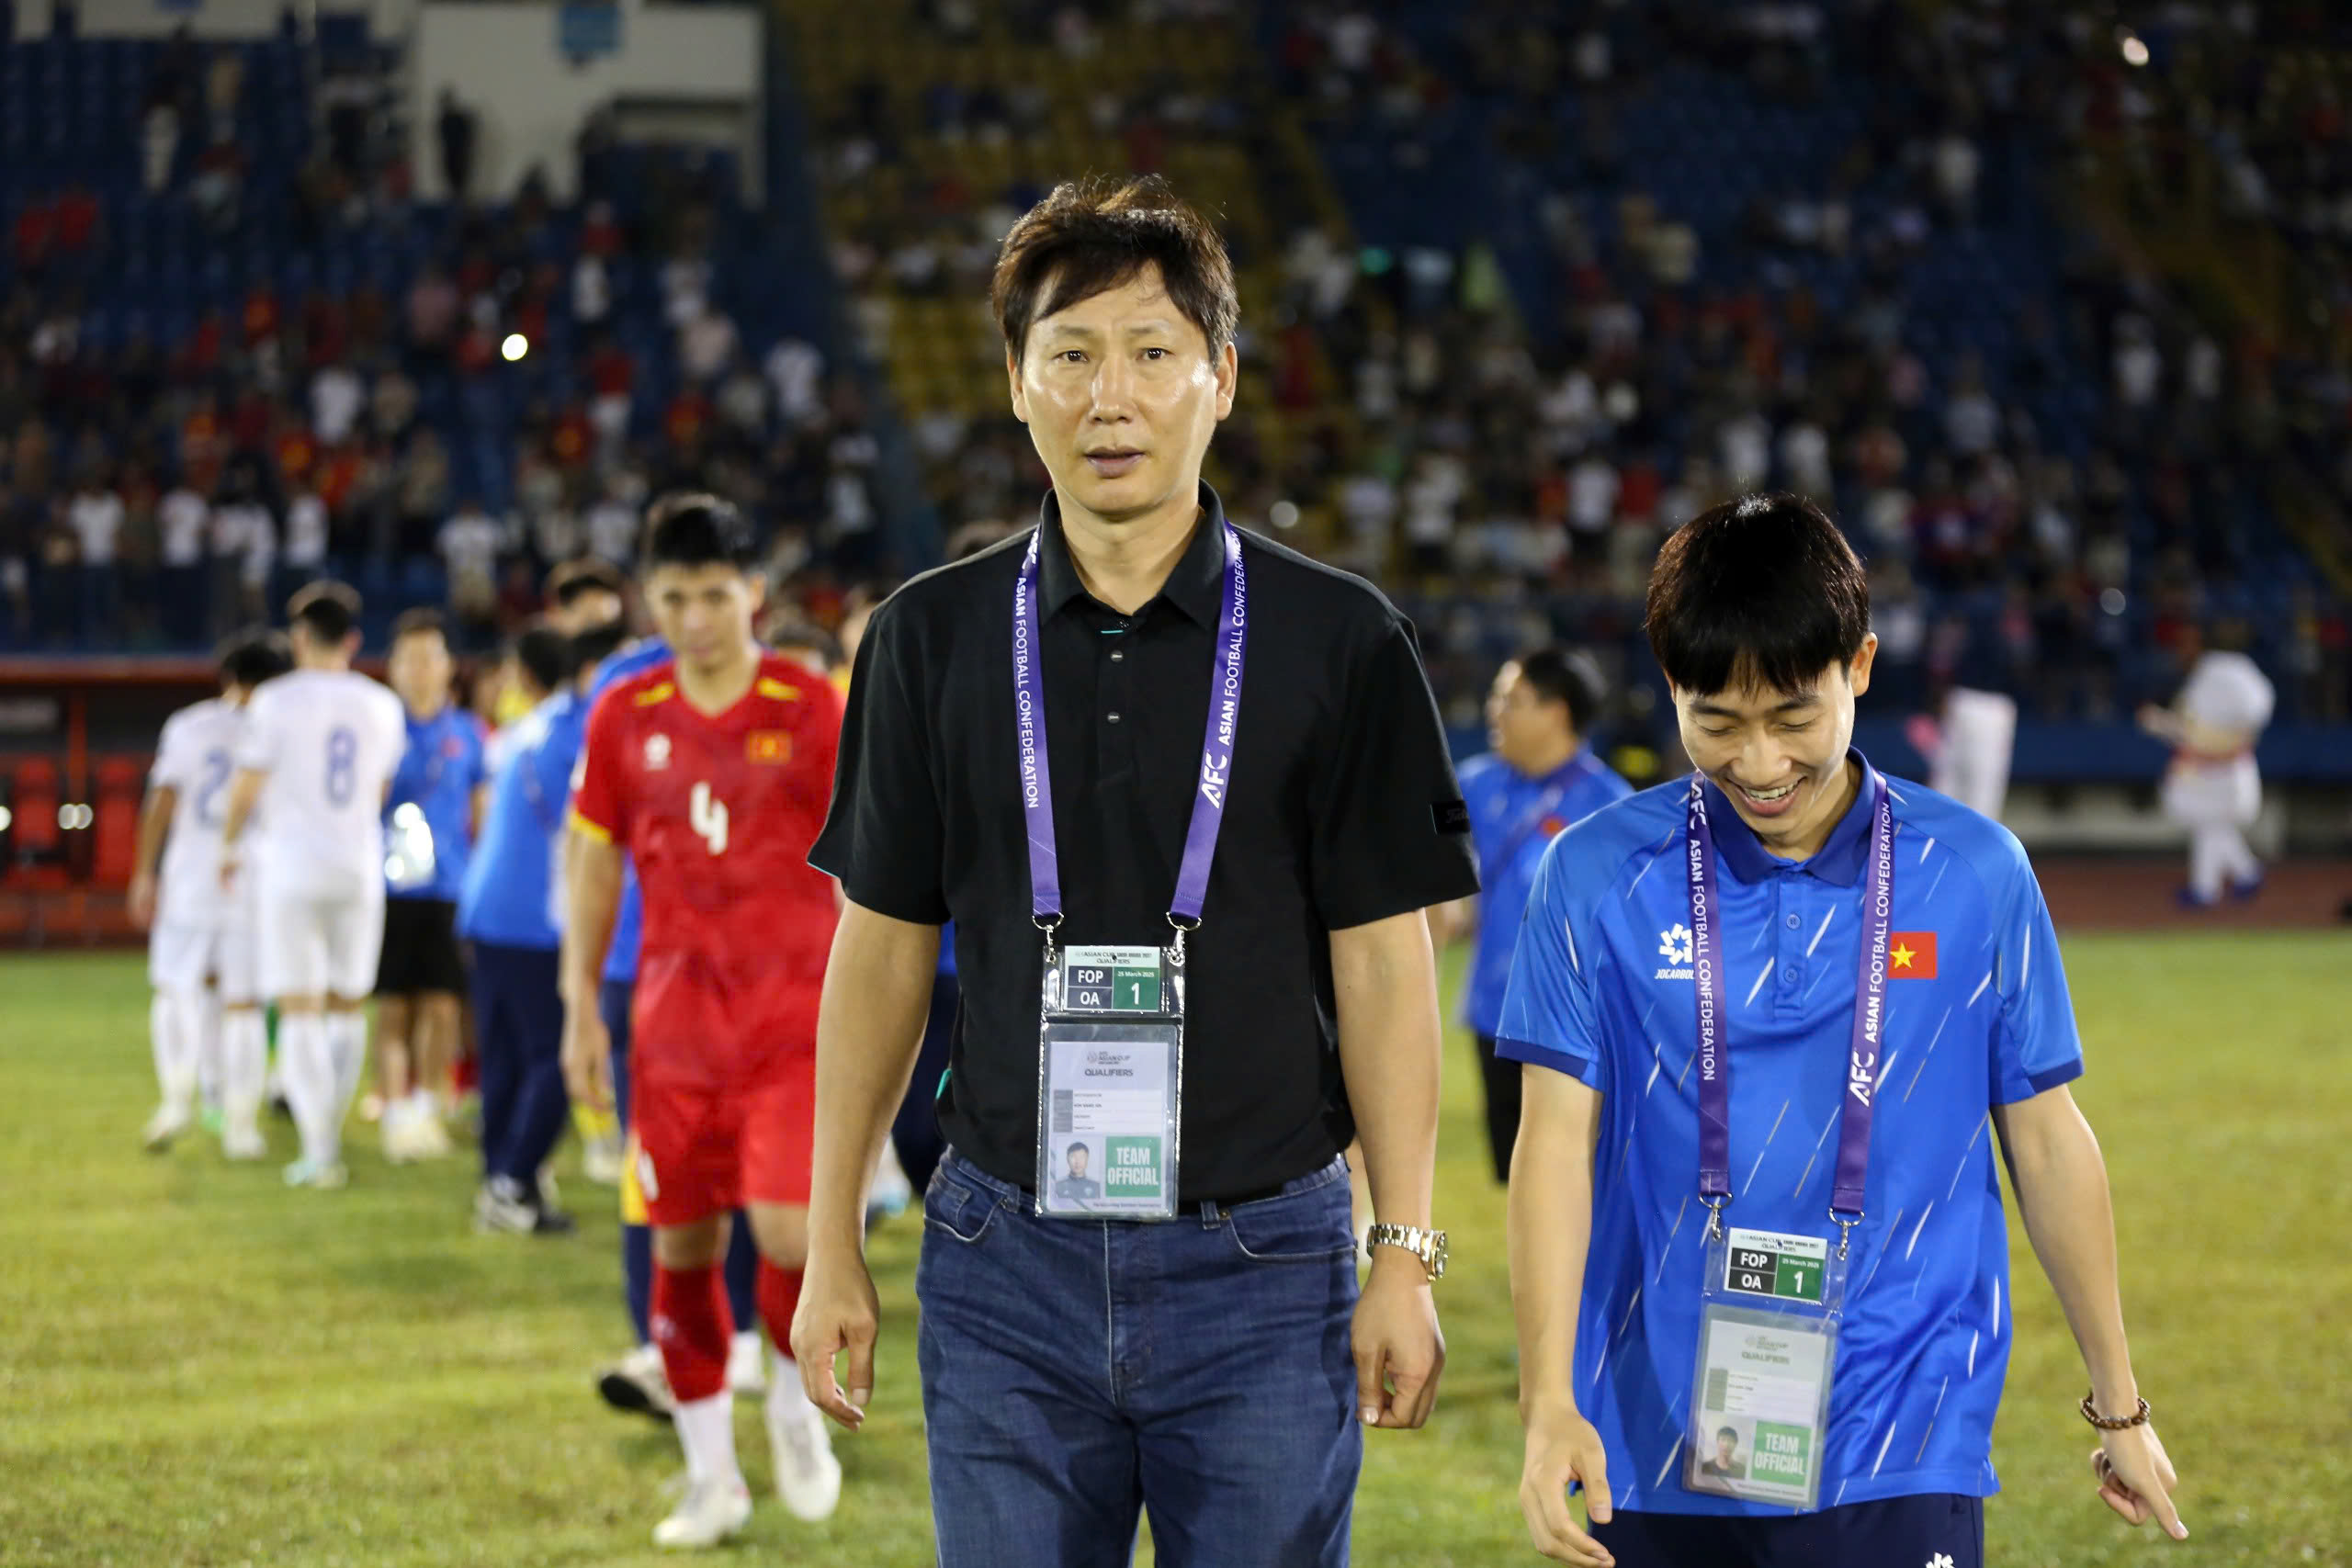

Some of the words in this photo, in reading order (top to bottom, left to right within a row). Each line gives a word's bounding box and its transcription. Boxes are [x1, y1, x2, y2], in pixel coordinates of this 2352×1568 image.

[1015, 577, 1027, 617] ASIAN
[1232, 530, 1247, 627] CONFEDERATION
[1015, 619, 1030, 688] FOOTBALL
[1225, 629, 1243, 697] FOOTBALL
[1218, 700, 1236, 746] ASIAN
[326, 725, 358, 809] 8
[1018, 691, 1038, 808] CONFEDERATION
[1201, 752, 1227, 809] AFC
[690, 781, 729, 856] 4
[1690, 781, 1707, 829] AFC
[1690, 839, 1704, 883] ASIAN
[1876, 802, 1891, 917] CONFEDERATION
[1692, 885, 1710, 955] FOOTBALL
[1078, 970, 1104, 984] FOP
[1655, 969, 1695, 980] JOGARBOL
[1870, 921, 1888, 993] FOOTBALL
[1080, 992, 1101, 1006] OA
[1131, 983, 1140, 1005] 1
[1698, 959, 1715, 1081] CONFEDERATION
[1864, 997, 1881, 1043] ASIAN
[1084, 1068, 1134, 1077] QUALIFIERS
[1849, 1051, 1874, 1107] AFC
[1108, 1167, 1159, 1186] OFFICIAL
[1116, 1146, 1150, 1166] TEAM
[1740, 1252, 1768, 1269] FOP
[1741, 1273, 1762, 1290] OA
[1793, 1270, 1804, 1293] 1
[1754, 1450, 1806, 1476] OFFICIAL
[1766, 1432, 1800, 1454] TEAM
